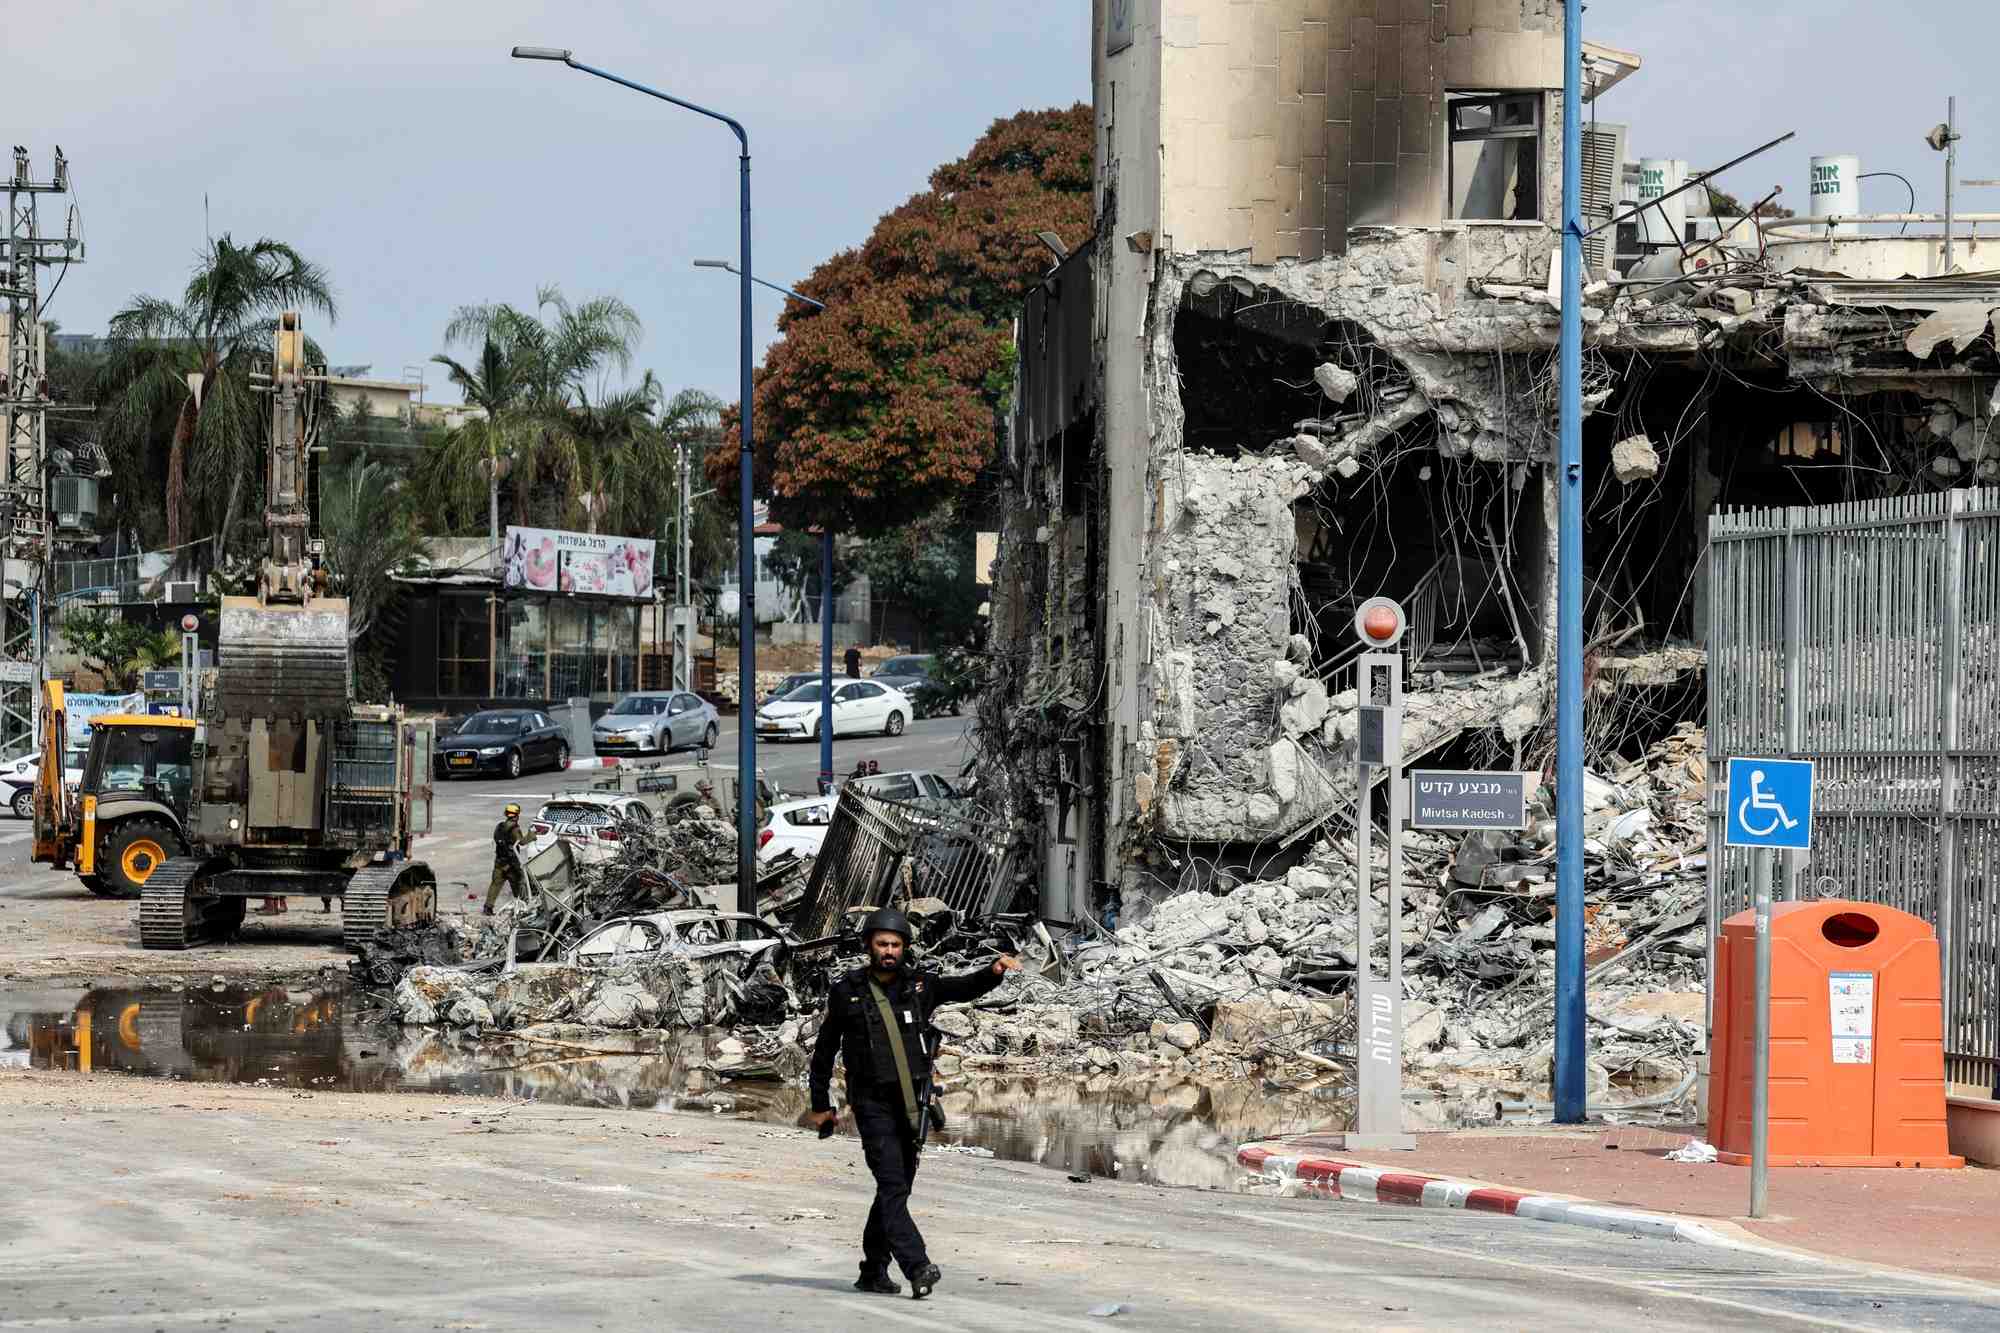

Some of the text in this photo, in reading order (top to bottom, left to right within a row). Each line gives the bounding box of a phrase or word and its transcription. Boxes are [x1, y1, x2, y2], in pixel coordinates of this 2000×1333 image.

[1420, 782, 1454, 796] קדש
[1458, 782, 1502, 795] מבצע
[1422, 807, 1458, 818] Mivtsa
[1462, 808, 1505, 819] Kadesh
[1364, 992, 1393, 1065] שדרות
